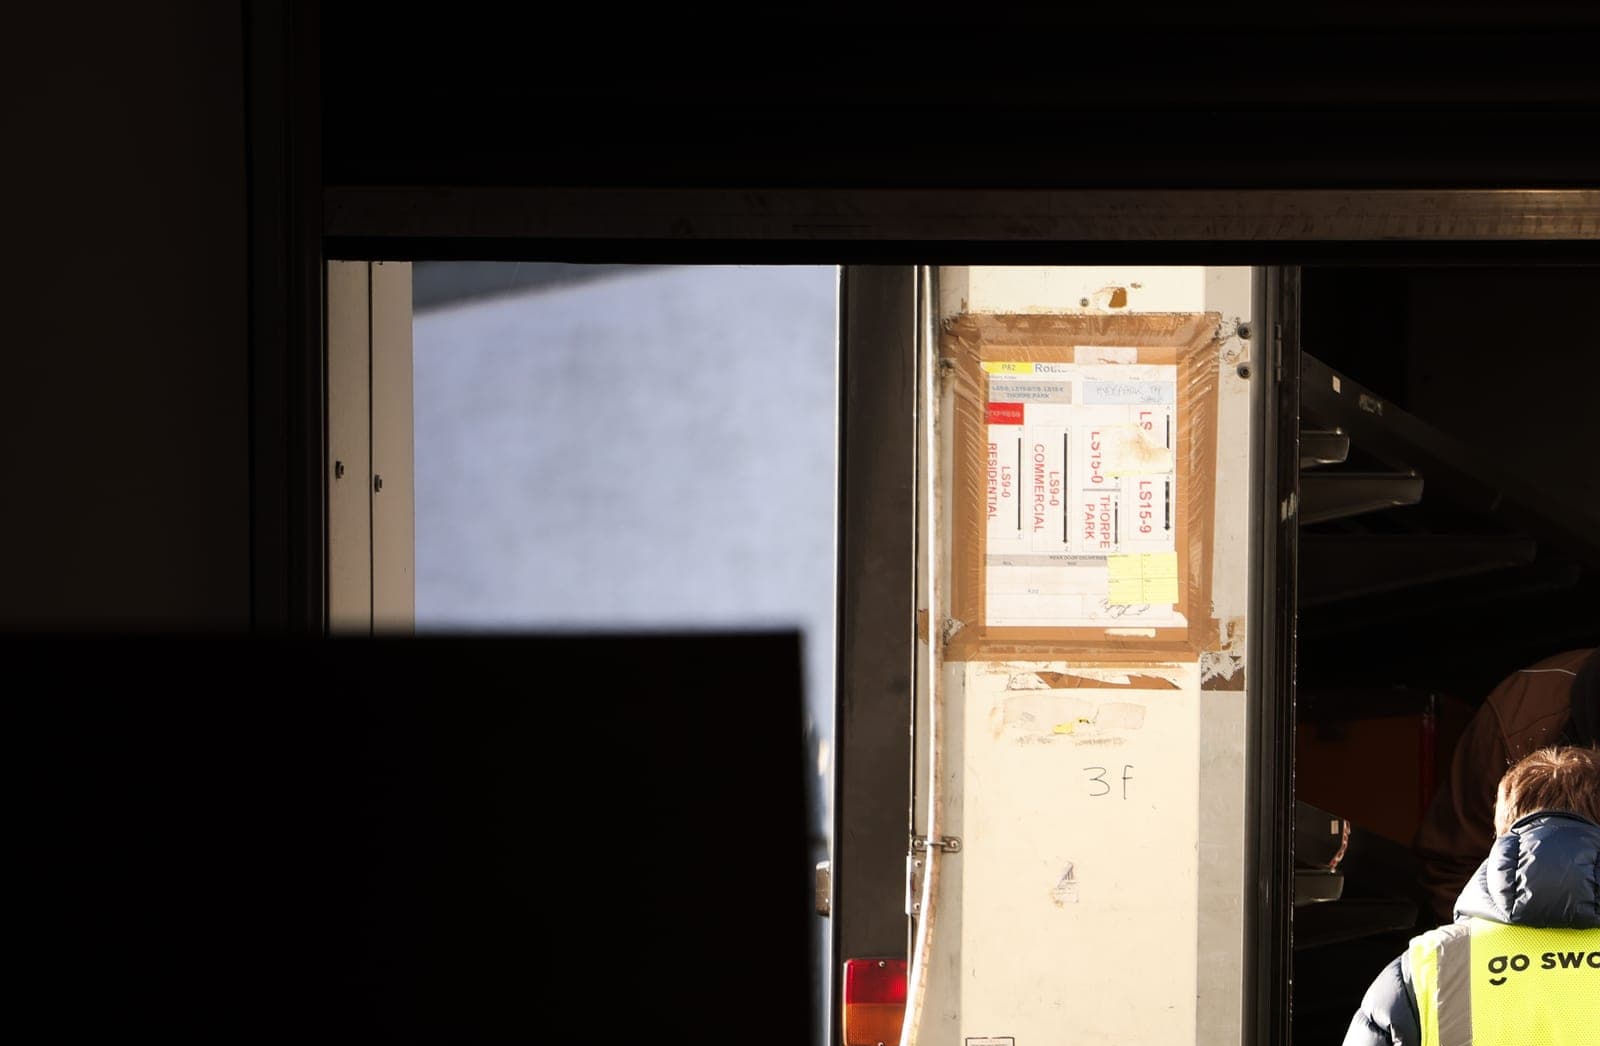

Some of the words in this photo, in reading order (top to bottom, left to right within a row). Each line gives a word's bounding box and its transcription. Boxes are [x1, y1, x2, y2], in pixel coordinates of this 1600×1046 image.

[987, 442, 997, 520] RESIDENTIAL
[1001, 466, 1011, 498] LS9-0
[1033, 443, 1045, 532] COMMERCIAL
[1049, 471, 1060, 506] LS9-0
[1085, 503, 1095, 540] PARK
[1100, 496, 1111, 549] THORPE
[1139, 480, 1152, 534] LS15-9
[1488, 954, 1530, 986] go
